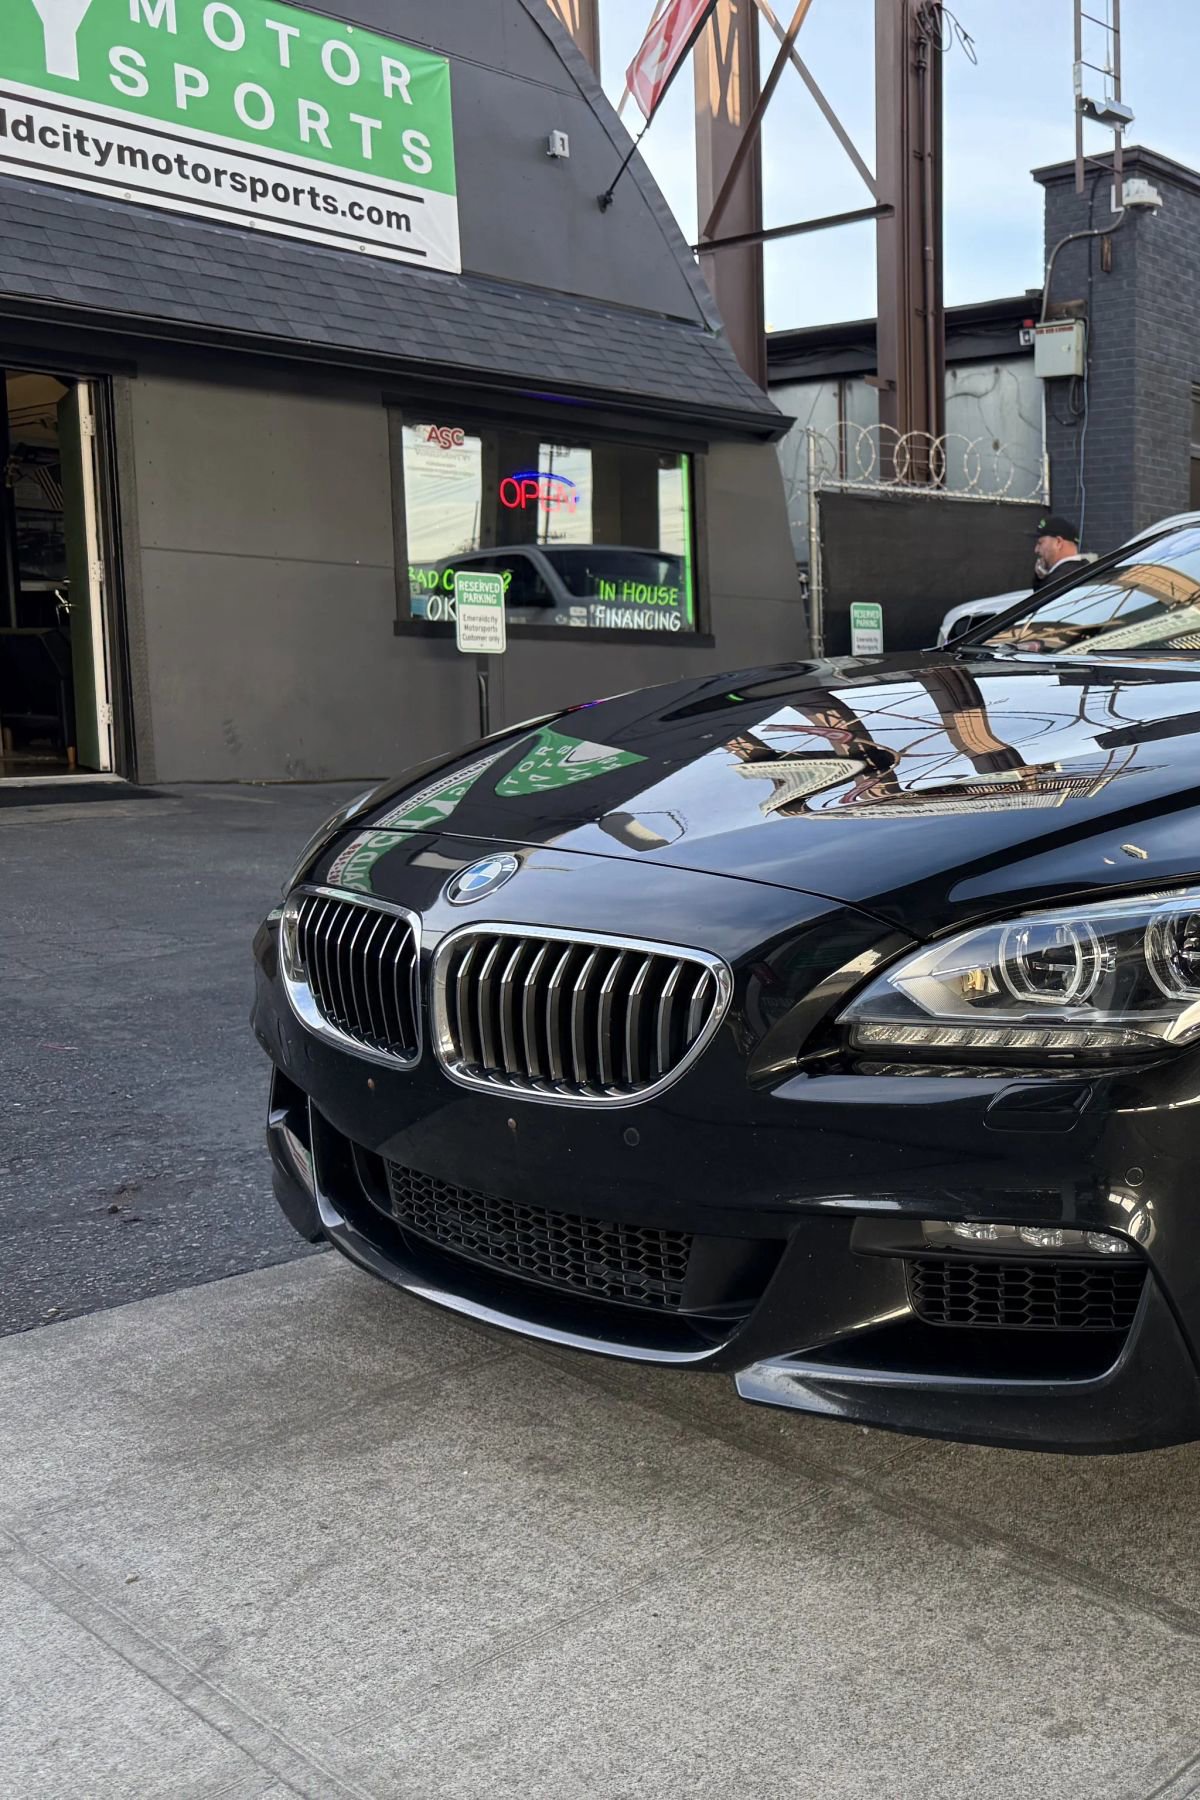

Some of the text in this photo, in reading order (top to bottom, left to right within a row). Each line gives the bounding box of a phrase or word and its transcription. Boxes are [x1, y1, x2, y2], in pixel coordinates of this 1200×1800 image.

[129, 0, 413, 105] MOTOR
[108, 45, 433, 174] SPORTS
[426, 426, 465, 450] ASC
[500, 477, 577, 513] OPEN
[459, 581, 500, 594] RESERVED
[463, 592, 497, 605] PARKING
[600, 580, 678, 606] IN HOUSE
[595, 605, 681, 632] FINANCING
